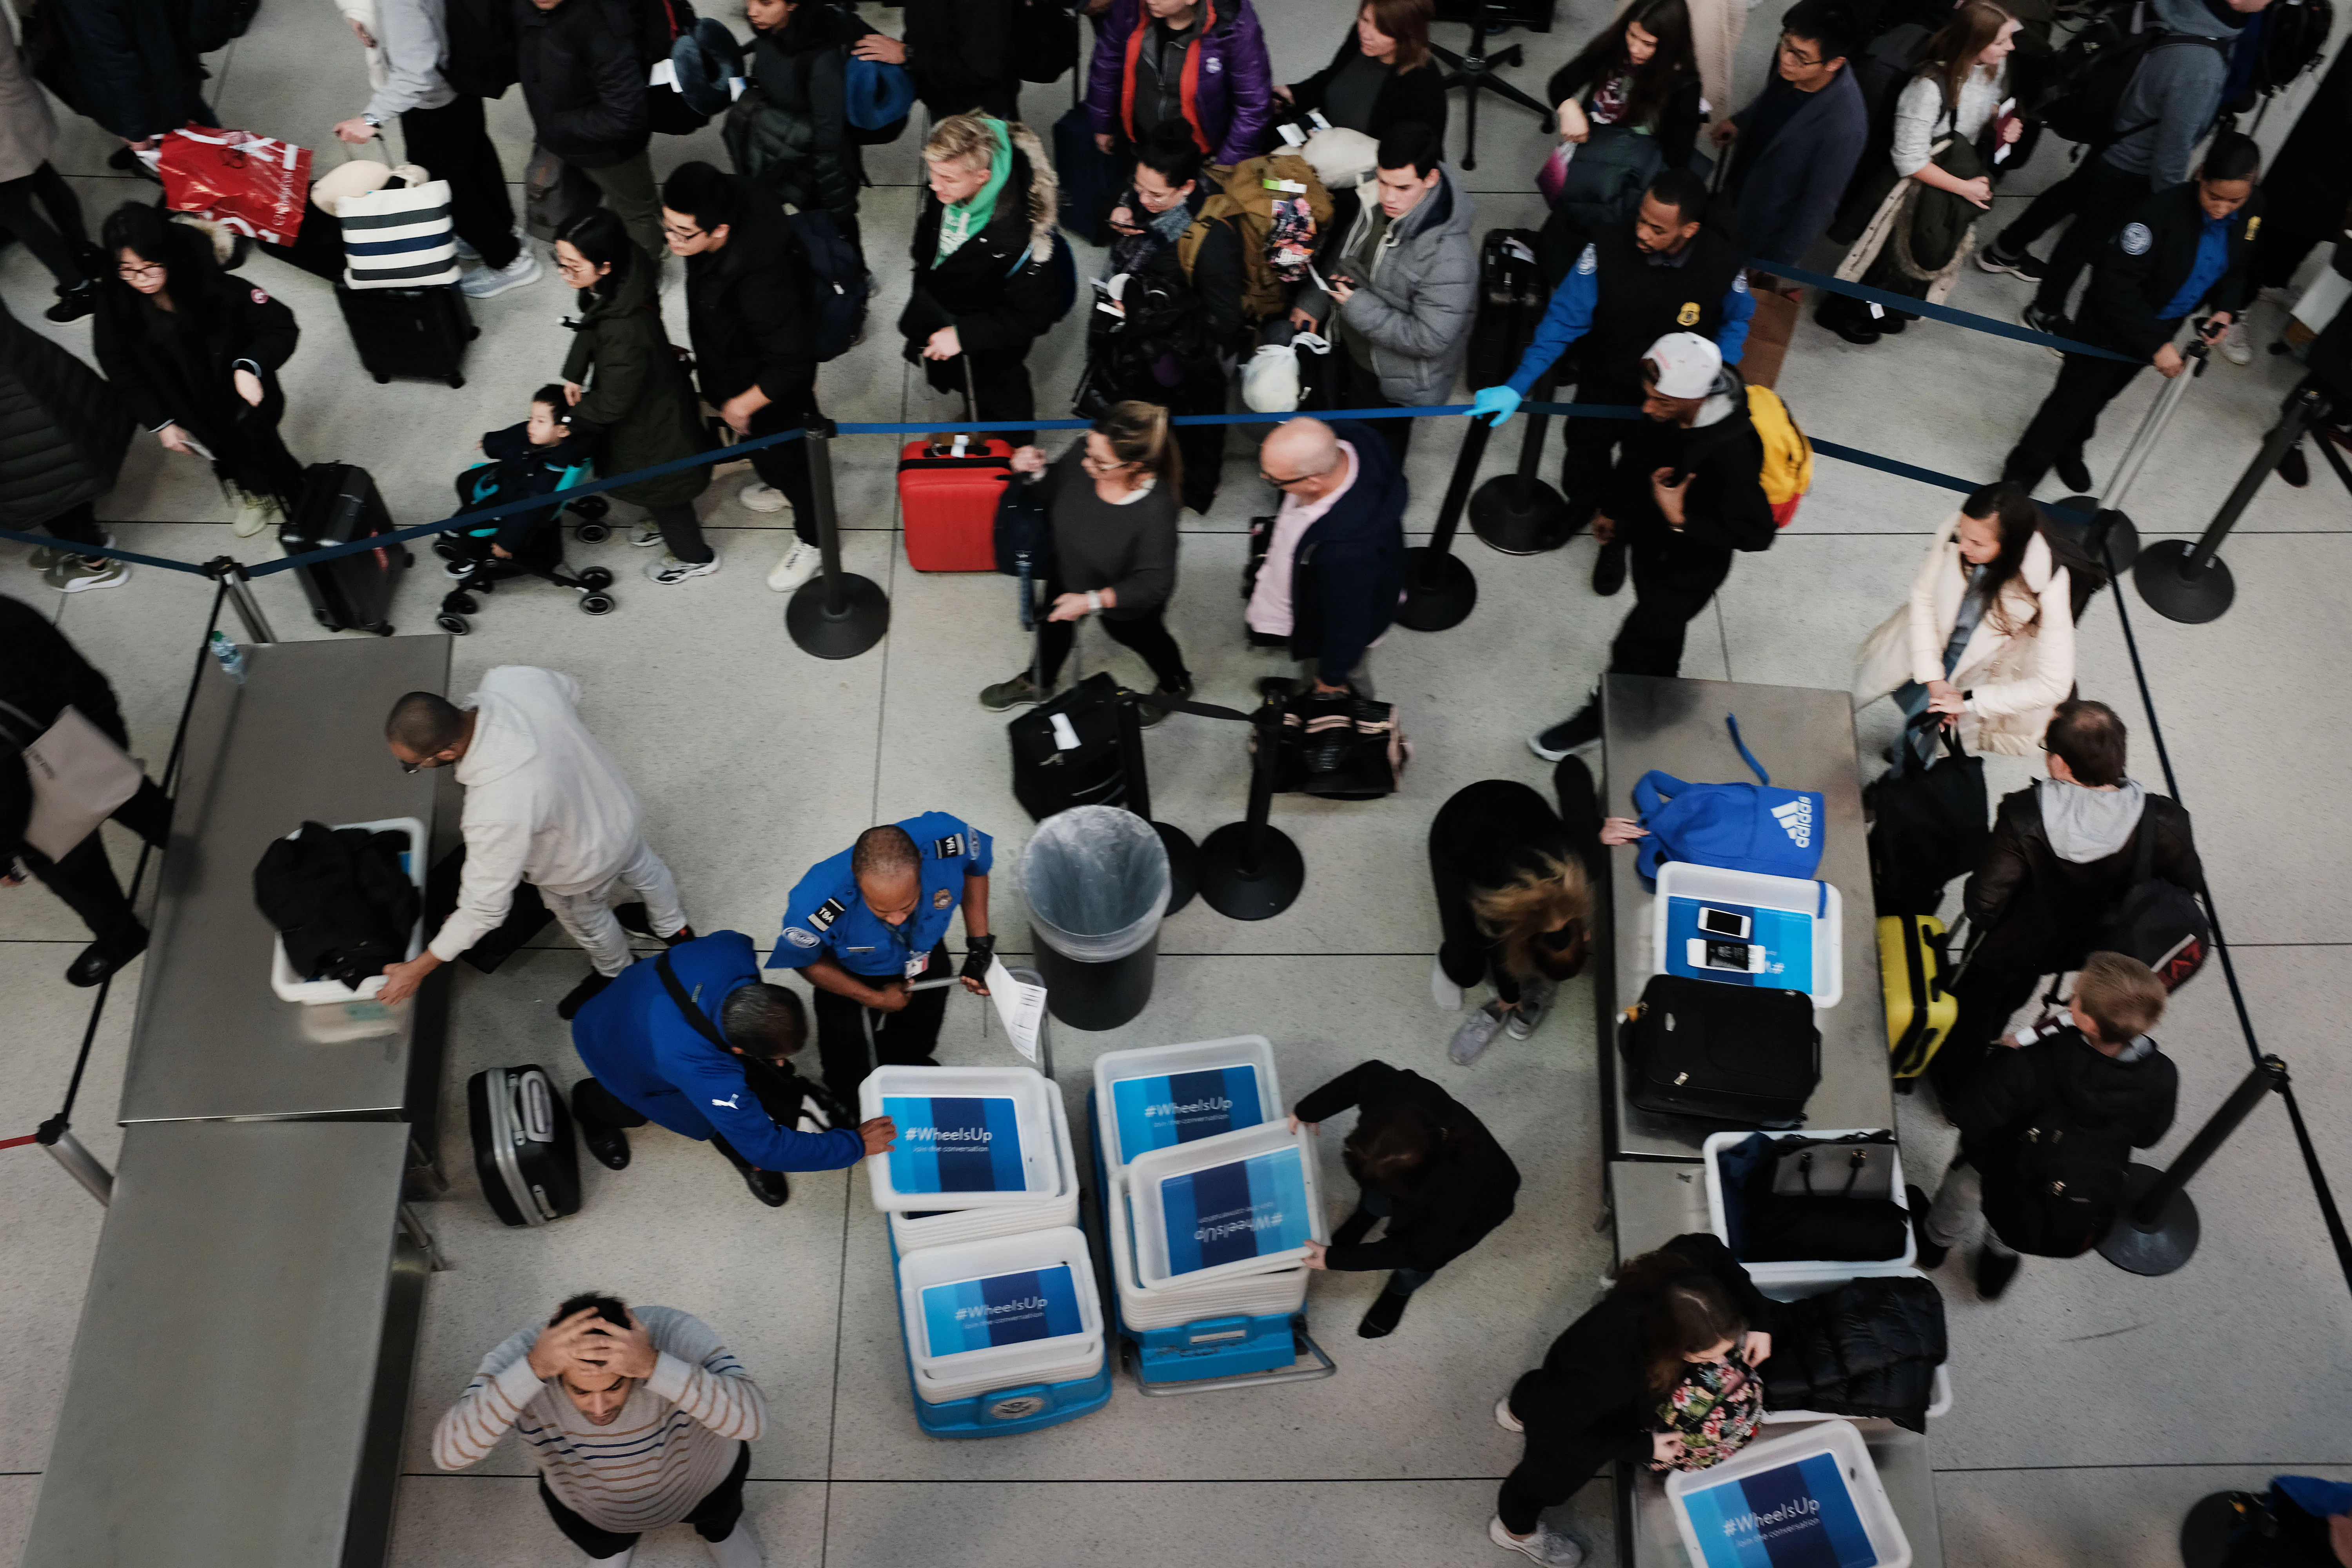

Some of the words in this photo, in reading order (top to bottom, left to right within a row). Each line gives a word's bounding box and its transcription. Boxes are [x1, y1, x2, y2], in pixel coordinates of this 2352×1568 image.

[1794, 796, 1812, 848] adidas
[945, 837, 956, 855] TSA
[818, 907, 835, 923] TSA
[1145, 1097, 1233, 1117] #WheelsUp
[905, 1127, 993, 1143] #WheelsUp
[1194, 1212, 1283, 1243] #WheelsUp
[955, 1296, 1048, 1321] #WheelsUp
[1722, 1496, 1820, 1537] #WheelsUp
